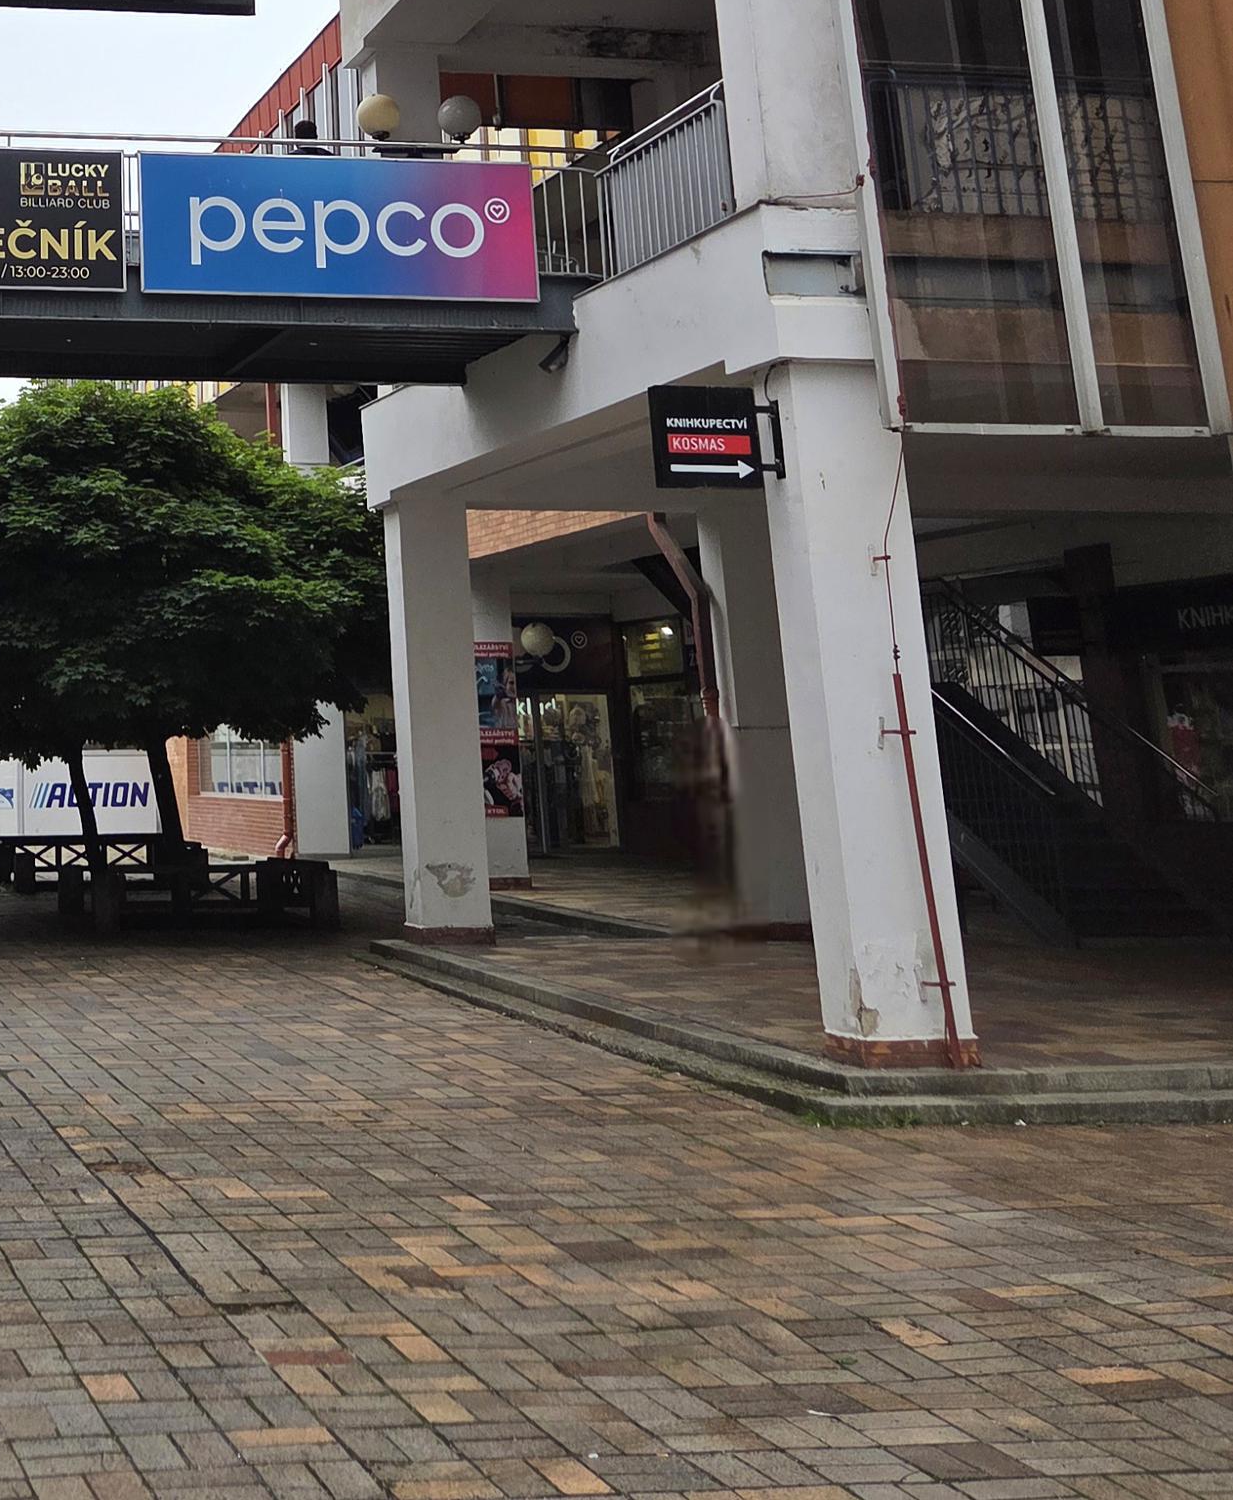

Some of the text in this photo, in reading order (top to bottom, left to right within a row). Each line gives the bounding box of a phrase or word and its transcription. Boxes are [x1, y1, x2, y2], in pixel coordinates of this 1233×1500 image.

[47, 162, 110, 178] LUCKY
[47, 179, 110, 197] BALL
[20, 197, 110, 210] BILLIARD CLUB
[189, 196, 485, 268] pepco
[10, 265, 90, 279] 13:00-23:00
[666, 417, 748, 429] KNIHKUPECTVÍ
[672, 437, 726, 452] KOSMAS
[46, 781, 150, 808] ATION
